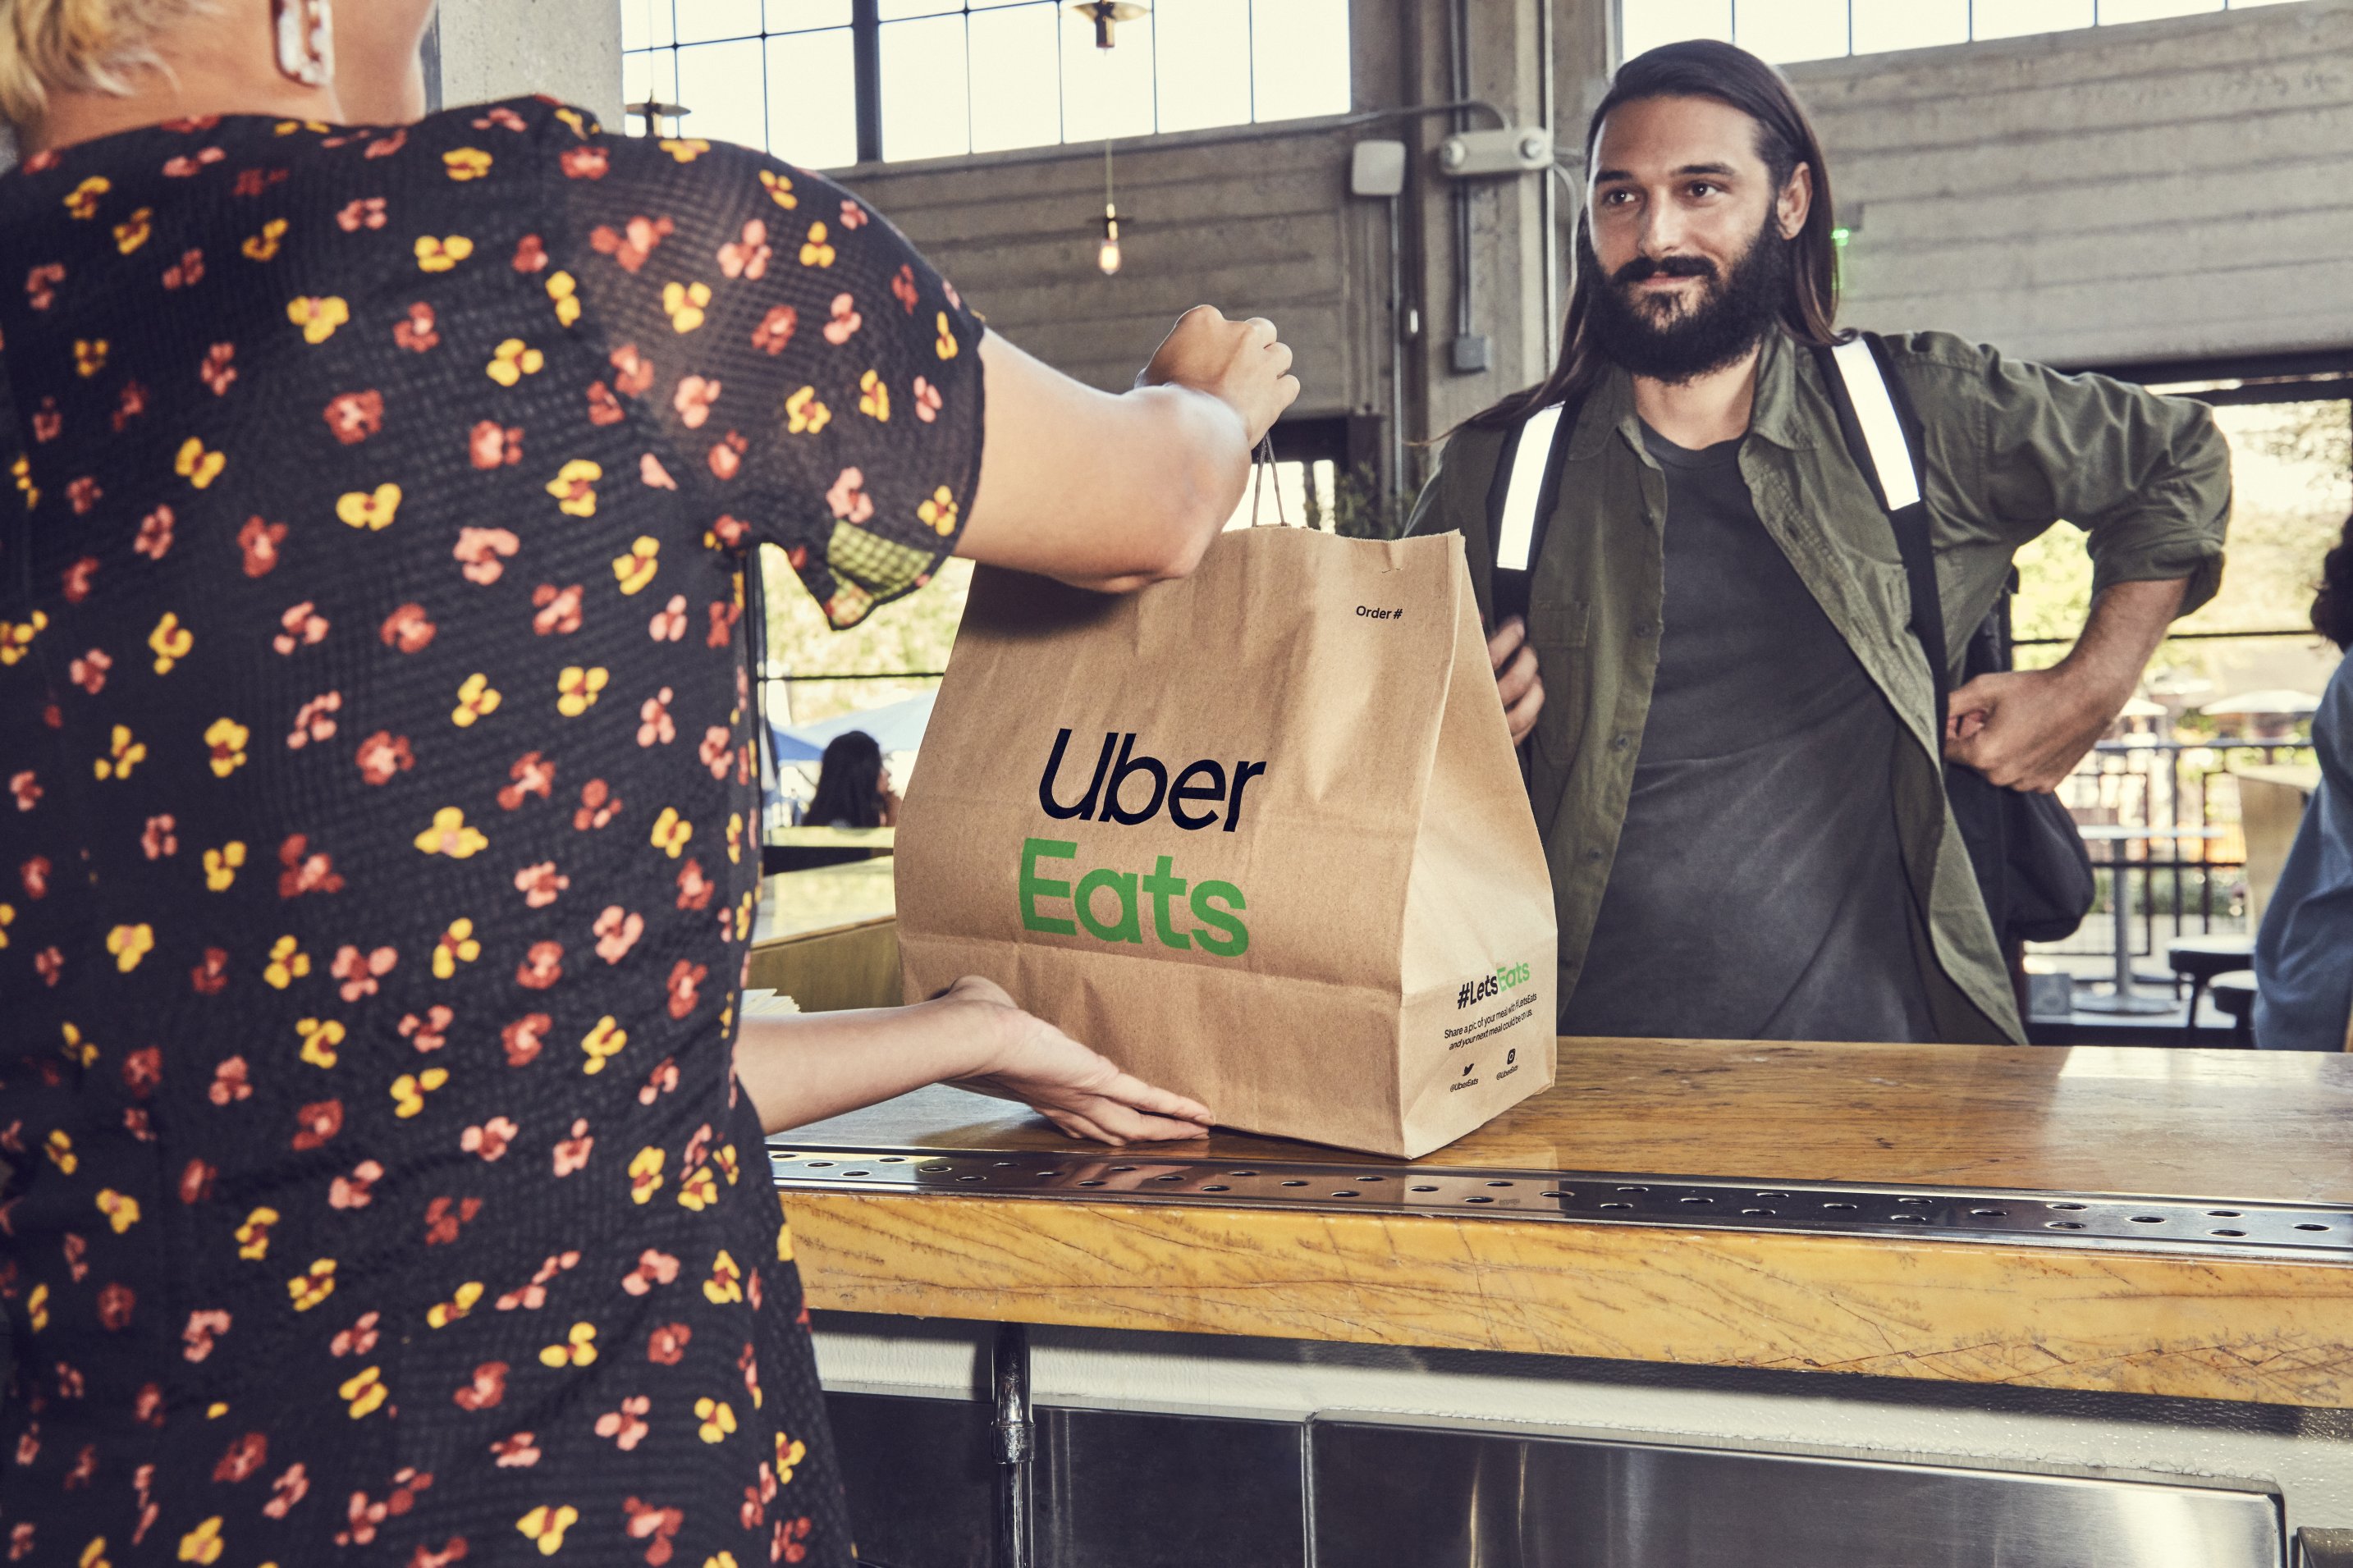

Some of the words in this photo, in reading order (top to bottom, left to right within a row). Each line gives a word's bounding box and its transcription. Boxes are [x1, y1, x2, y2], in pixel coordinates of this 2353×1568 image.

[1356, 606, 1392, 619] Order
[1394, 609, 1403, 619] #
[1039, 728, 1266, 832] Uber
[1019, 838, 1249, 958] Eats
[1458, 962, 1530, 1009] #LetsEats
[1444, 1027, 1463, 1039] Share
[1467, 1022, 1476, 1034] pic
[1477, 1017, 1483, 1027] of
[1484, 1014, 1495, 1027] your
[1496, 1007, 1508, 1020] meal
[1449, 1039, 1462, 1050] and
[1461, 1035, 1476, 1048] your
[1476, 1029, 1488, 1041] next
[1489, 1023, 1502, 1036] meal
[1503, 1017, 1515, 1031] could
[1515, 1016, 1521, 1024] be
[1450, 1078, 1479, 1092] @UberEats
